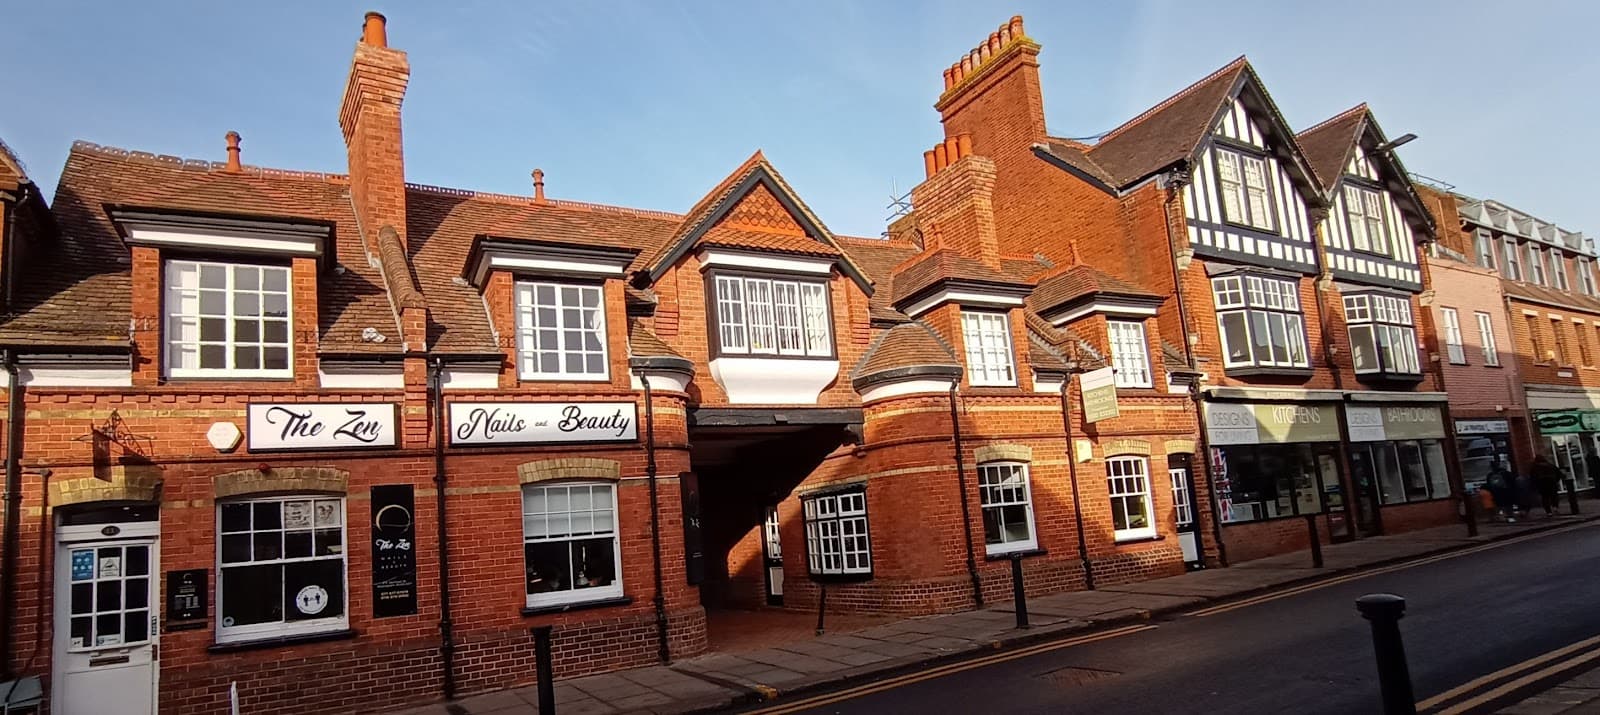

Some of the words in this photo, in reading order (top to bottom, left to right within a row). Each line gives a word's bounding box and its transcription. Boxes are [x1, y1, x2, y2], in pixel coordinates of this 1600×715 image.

[457, 408, 526, 440] Nails
[558, 405, 630, 437] Beauty
[1271, 406, 1320, 424] KITCHENS
[1387, 406, 1437, 422] BATHROOMS
[266, 406, 325, 441] The
[333, 408, 383, 443] Zen
[375, 538, 394, 551] The
[395, 538, 410, 550] Zen
